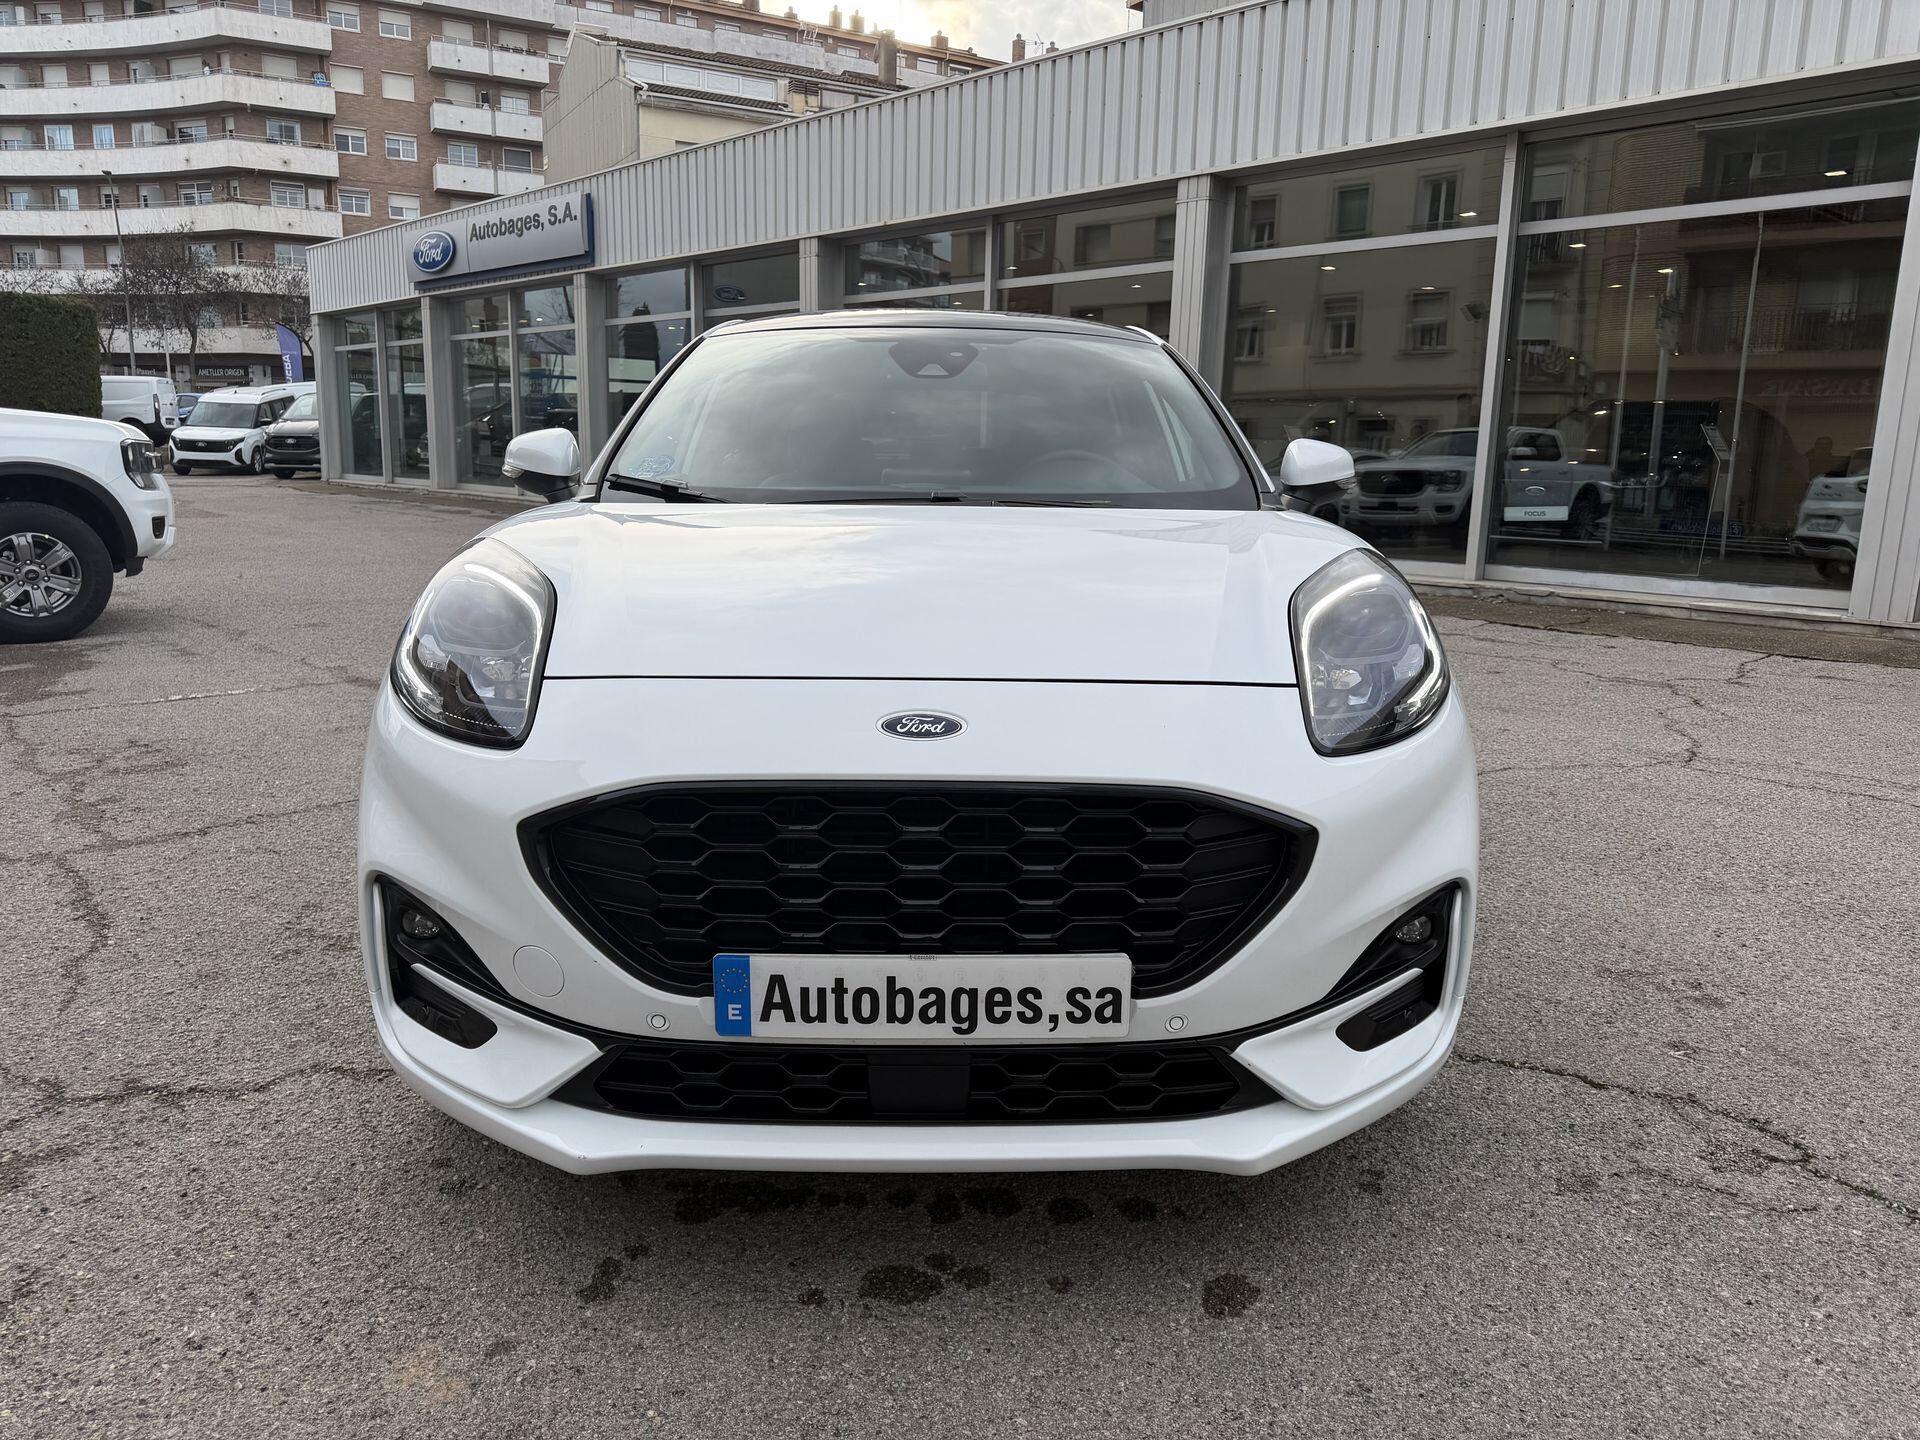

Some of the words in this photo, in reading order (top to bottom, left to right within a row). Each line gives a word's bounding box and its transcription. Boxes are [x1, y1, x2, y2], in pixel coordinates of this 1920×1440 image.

[469, 212, 545, 242] Autobages,
[547, 201, 578, 225] S.A.
[418, 238, 444, 264] Ford
[224, 368, 245, 376] ORIGEN
[896, 716, 946, 733] Ford
[727, 1003, 742, 1020] E
[758, 973, 1123, 1036] Autobages,sa
